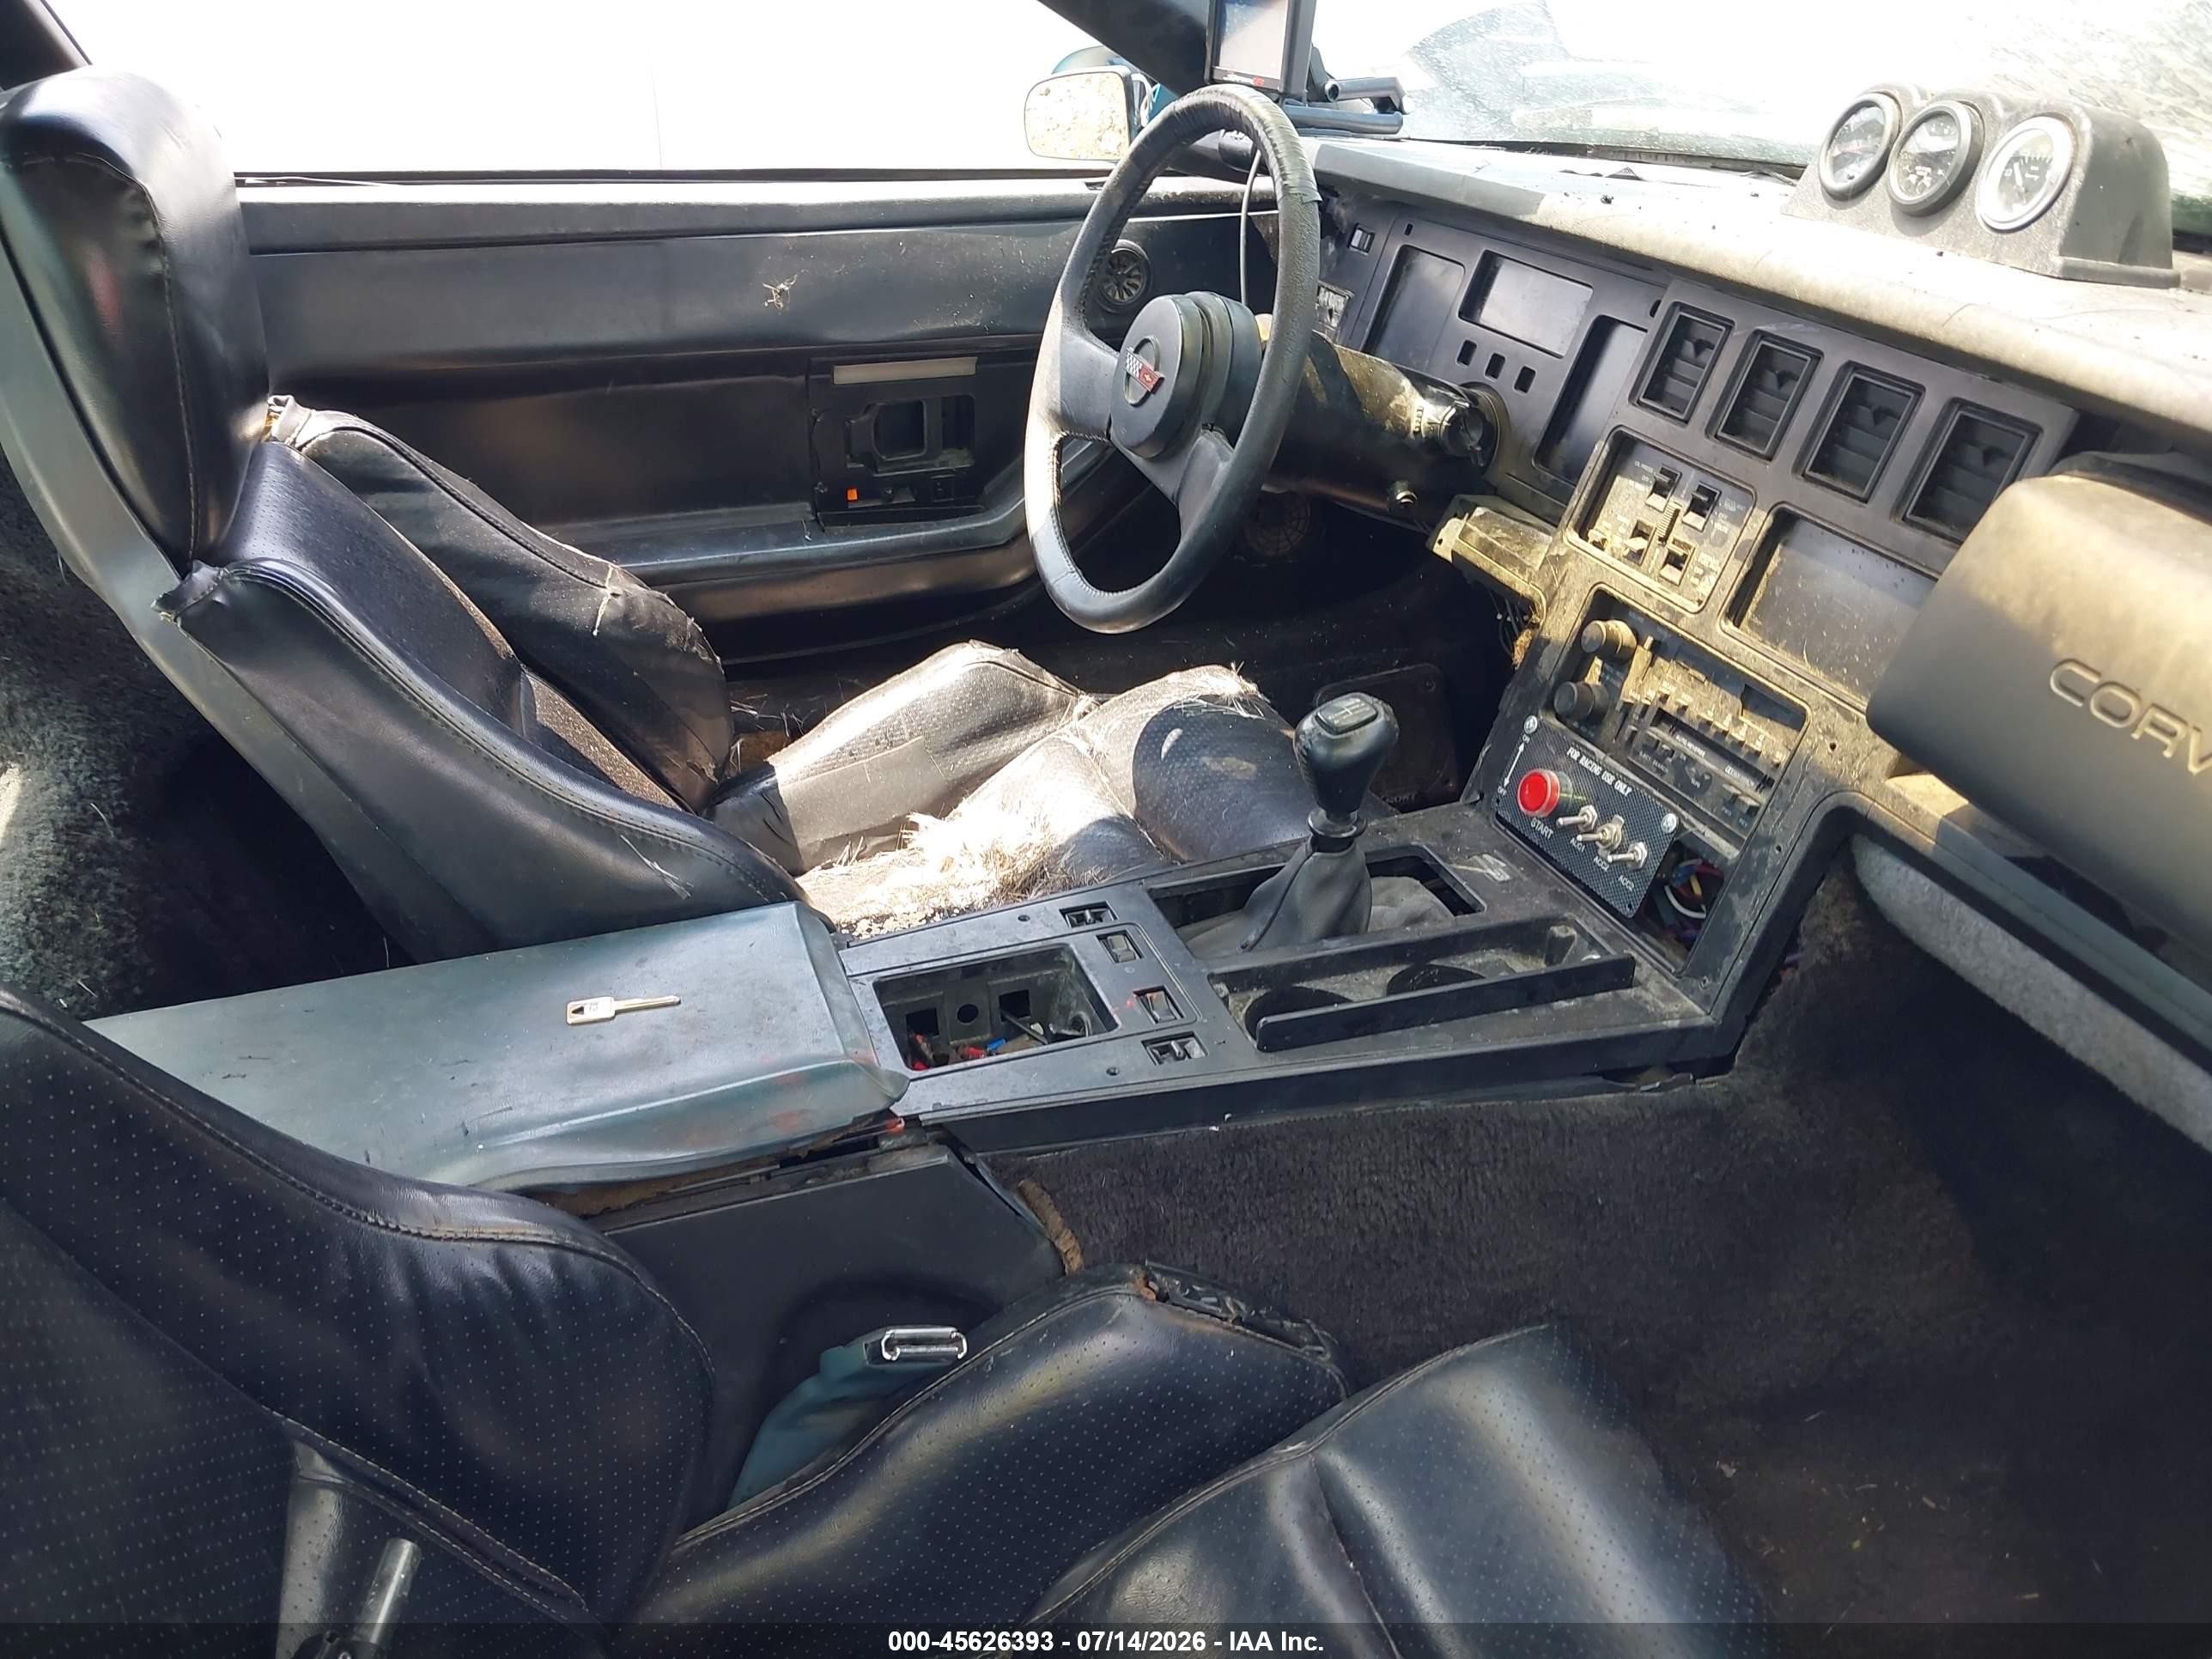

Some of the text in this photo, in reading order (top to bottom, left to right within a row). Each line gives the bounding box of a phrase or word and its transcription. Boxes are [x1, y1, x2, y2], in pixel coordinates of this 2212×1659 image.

[1566, 746, 1632, 797] FOR RACING USE ONLY
[1530, 817, 1554, 840] START
[1570, 837, 1586, 853] ACC1
